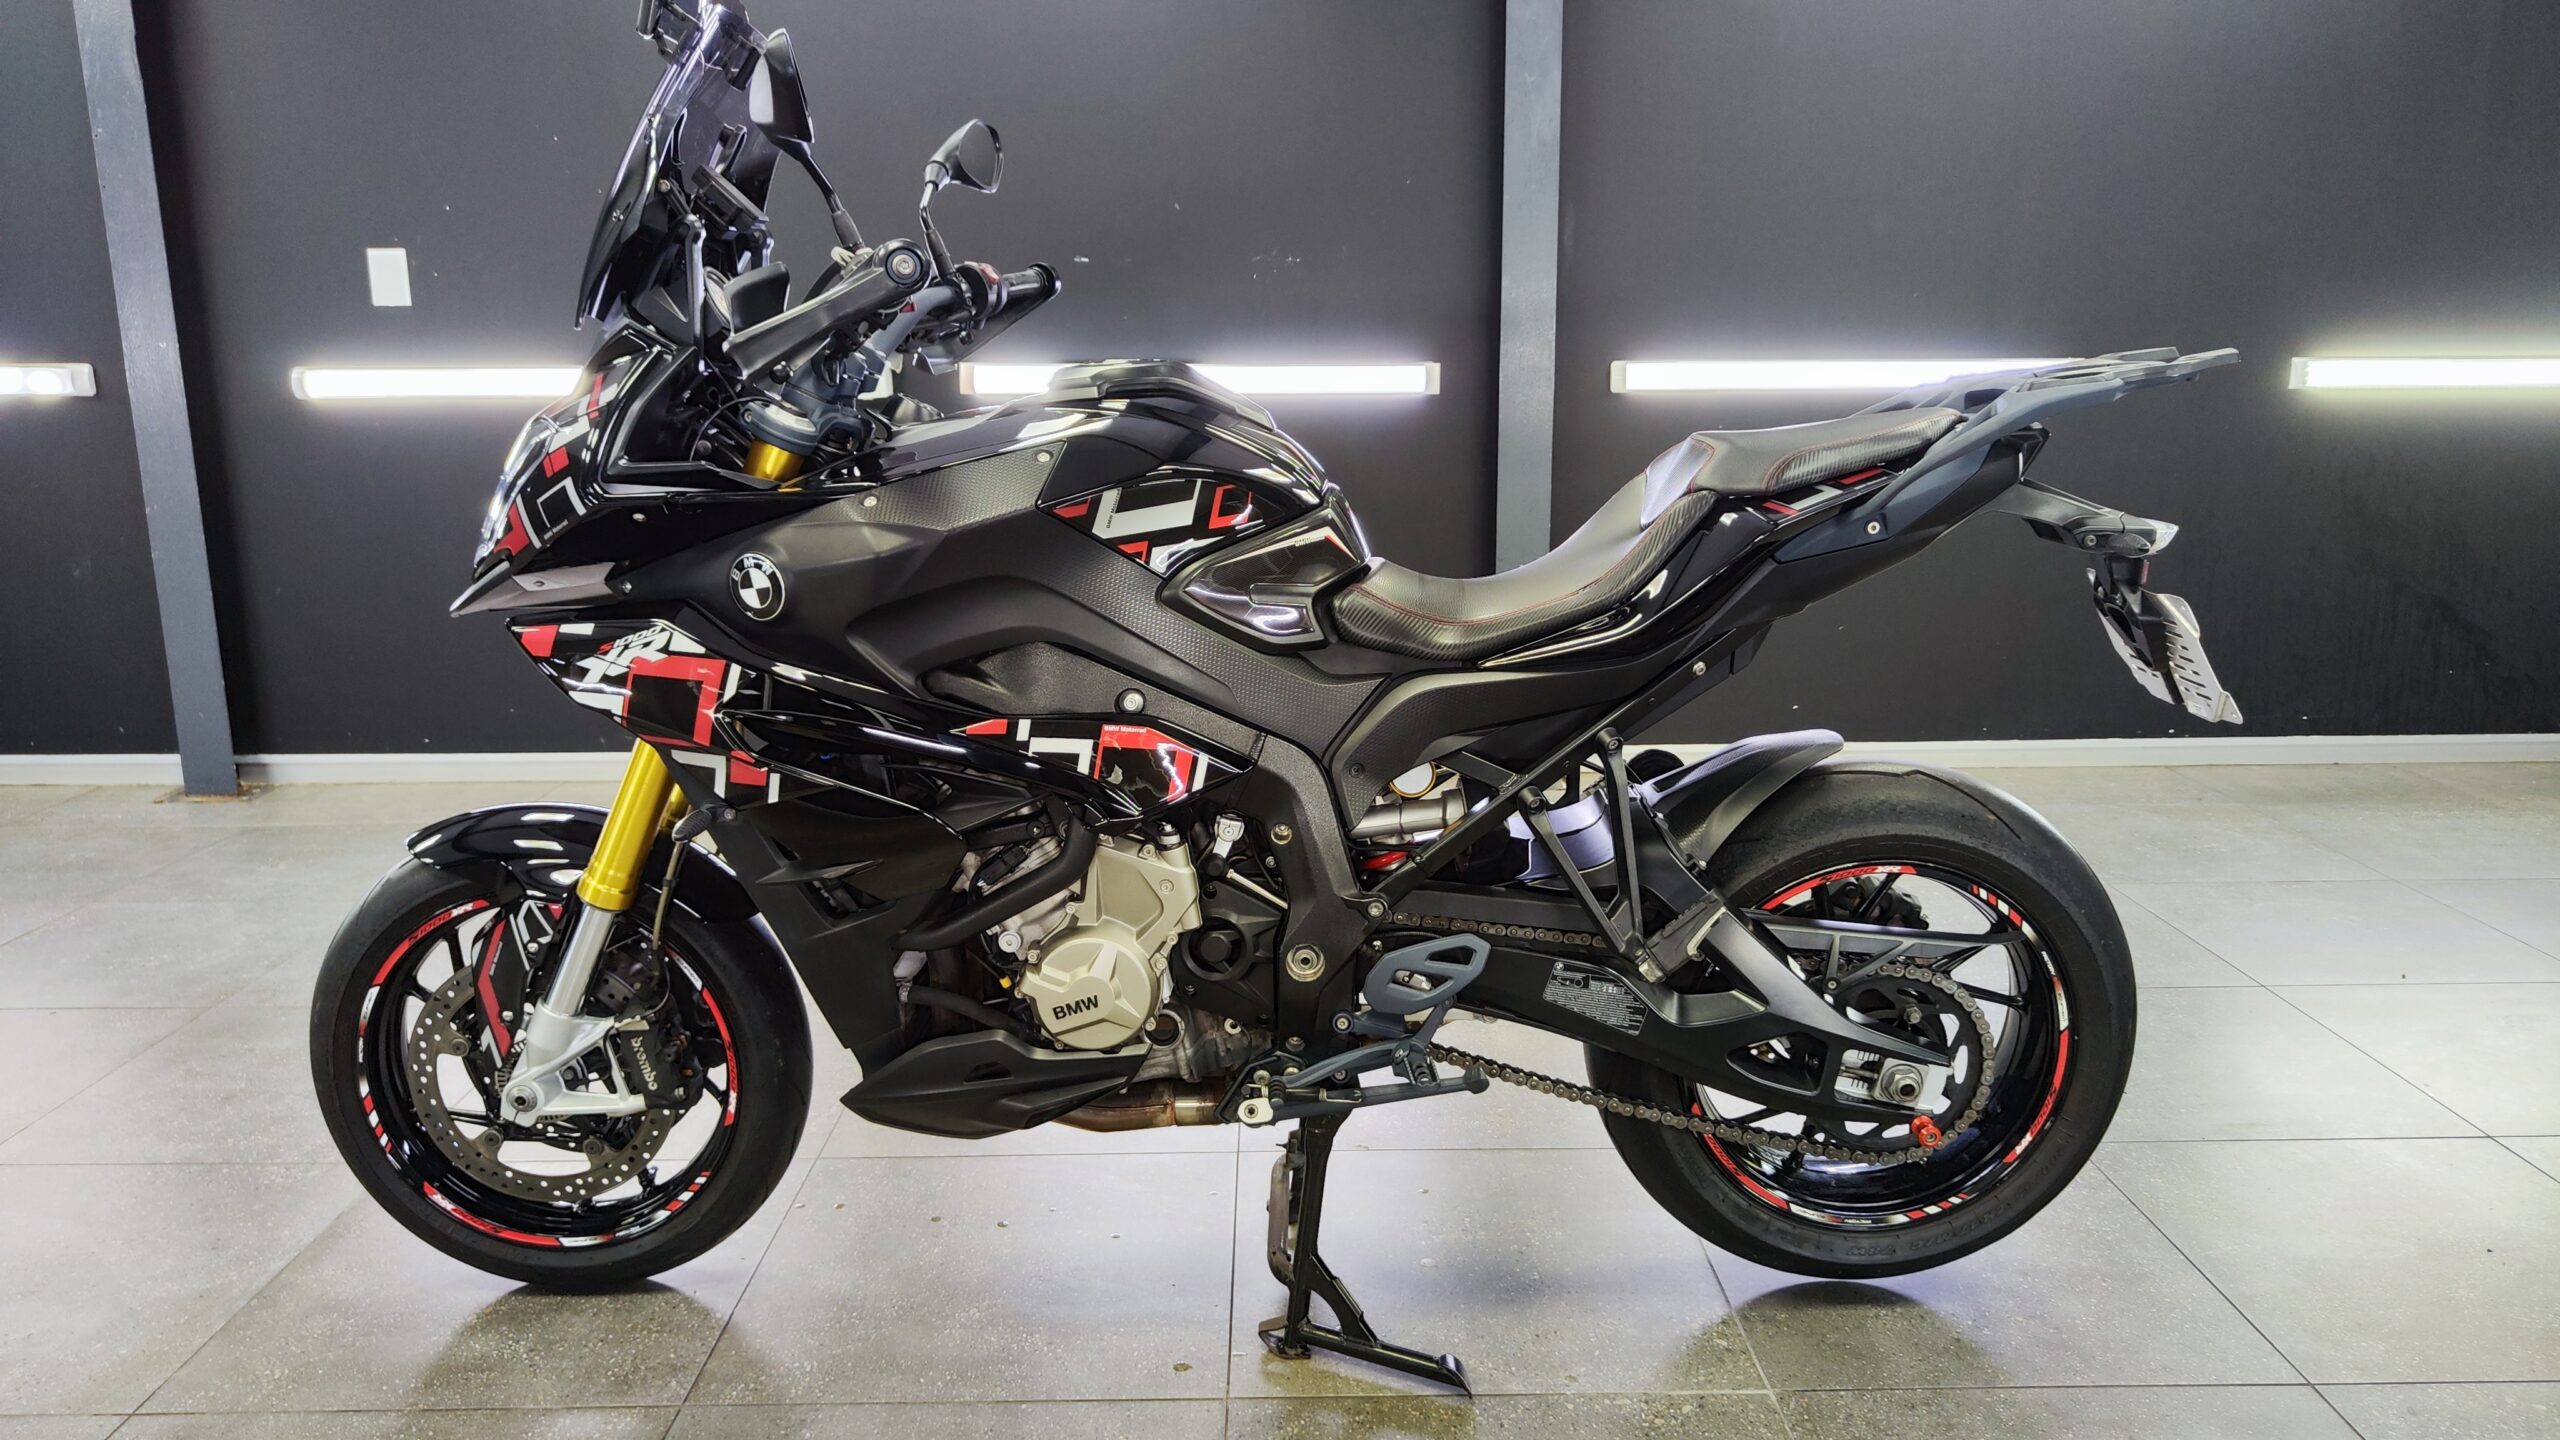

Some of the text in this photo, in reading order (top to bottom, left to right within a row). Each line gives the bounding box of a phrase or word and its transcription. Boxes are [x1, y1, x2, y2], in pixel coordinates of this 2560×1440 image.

[1106, 514, 1114, 528] BMW
[731, 556, 774, 581] BMW
[596, 625, 663, 655] S1000
[575, 630, 671, 685] XR
[1104, 724, 1119, 732] BMW
[1052, 995, 1098, 1020] BMW
[631, 1036, 658, 1091] brembo
